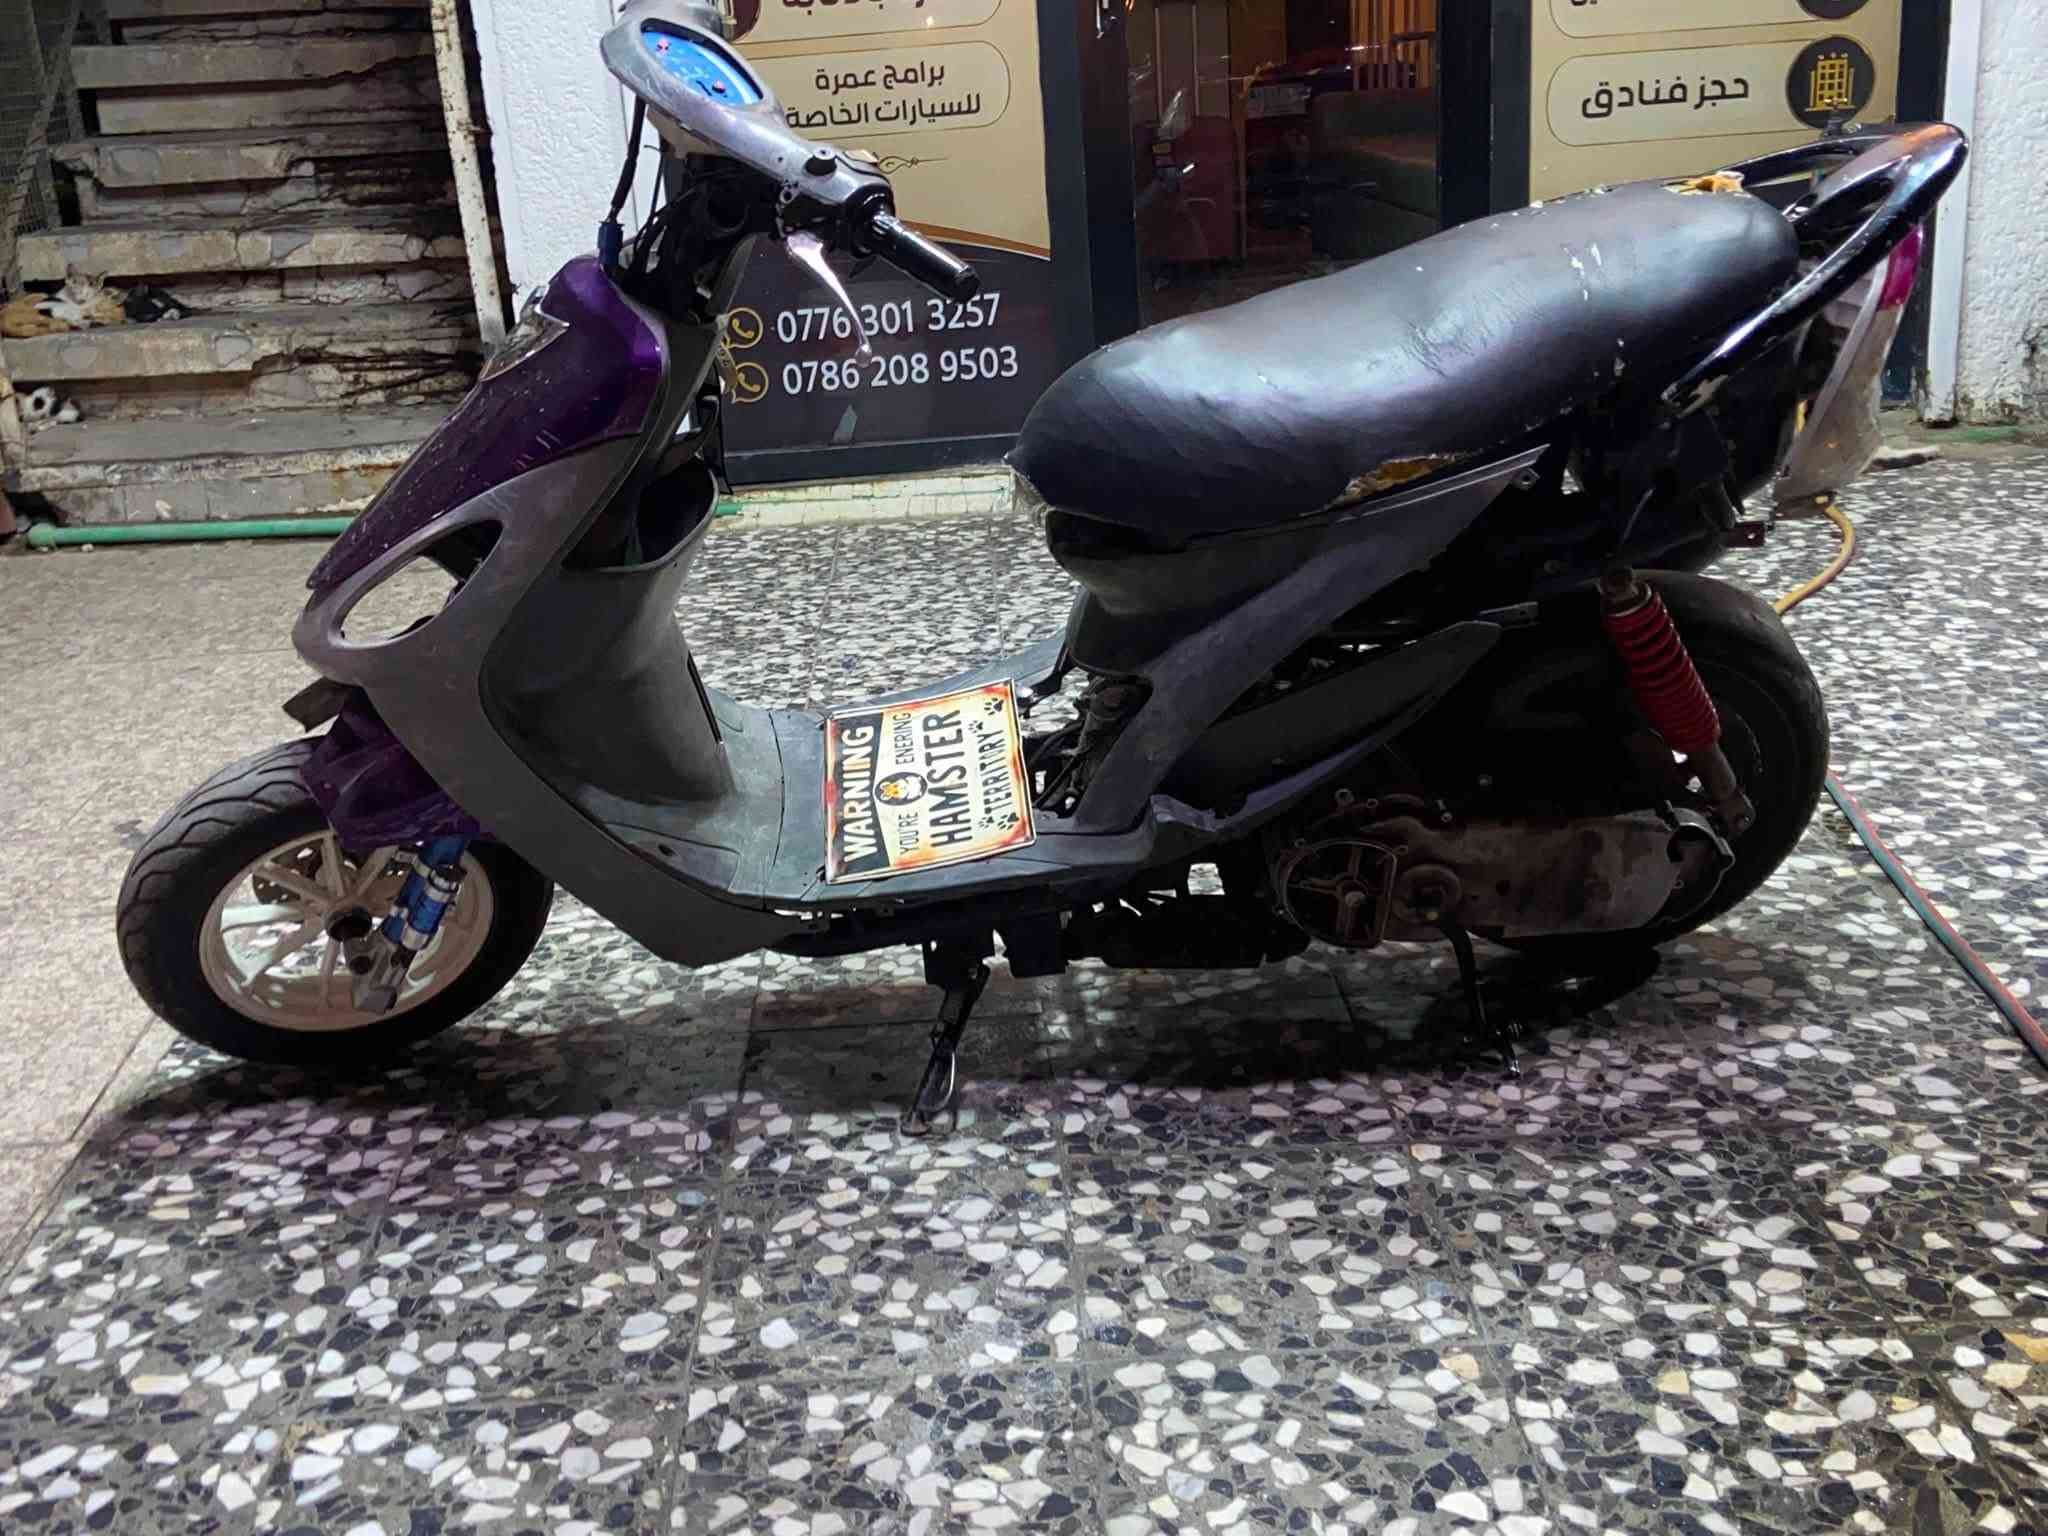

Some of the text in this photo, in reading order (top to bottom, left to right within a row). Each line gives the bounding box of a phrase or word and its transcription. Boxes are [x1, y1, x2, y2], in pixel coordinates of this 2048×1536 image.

[815, 61, 945, 96] برامج عمرة
[1581, 74, 1750, 119] حجز فنادق
[785, 93, 982, 129] للسيارات الخاصة
[776, 293, 1001, 343] 0776 301 3257
[782, 346, 1019, 395] 0786 208 9503
[841, 726, 879, 863] WARNING
[923, 709, 973, 847] HAMSTER
[977, 729, 1013, 815] TERRITORY
